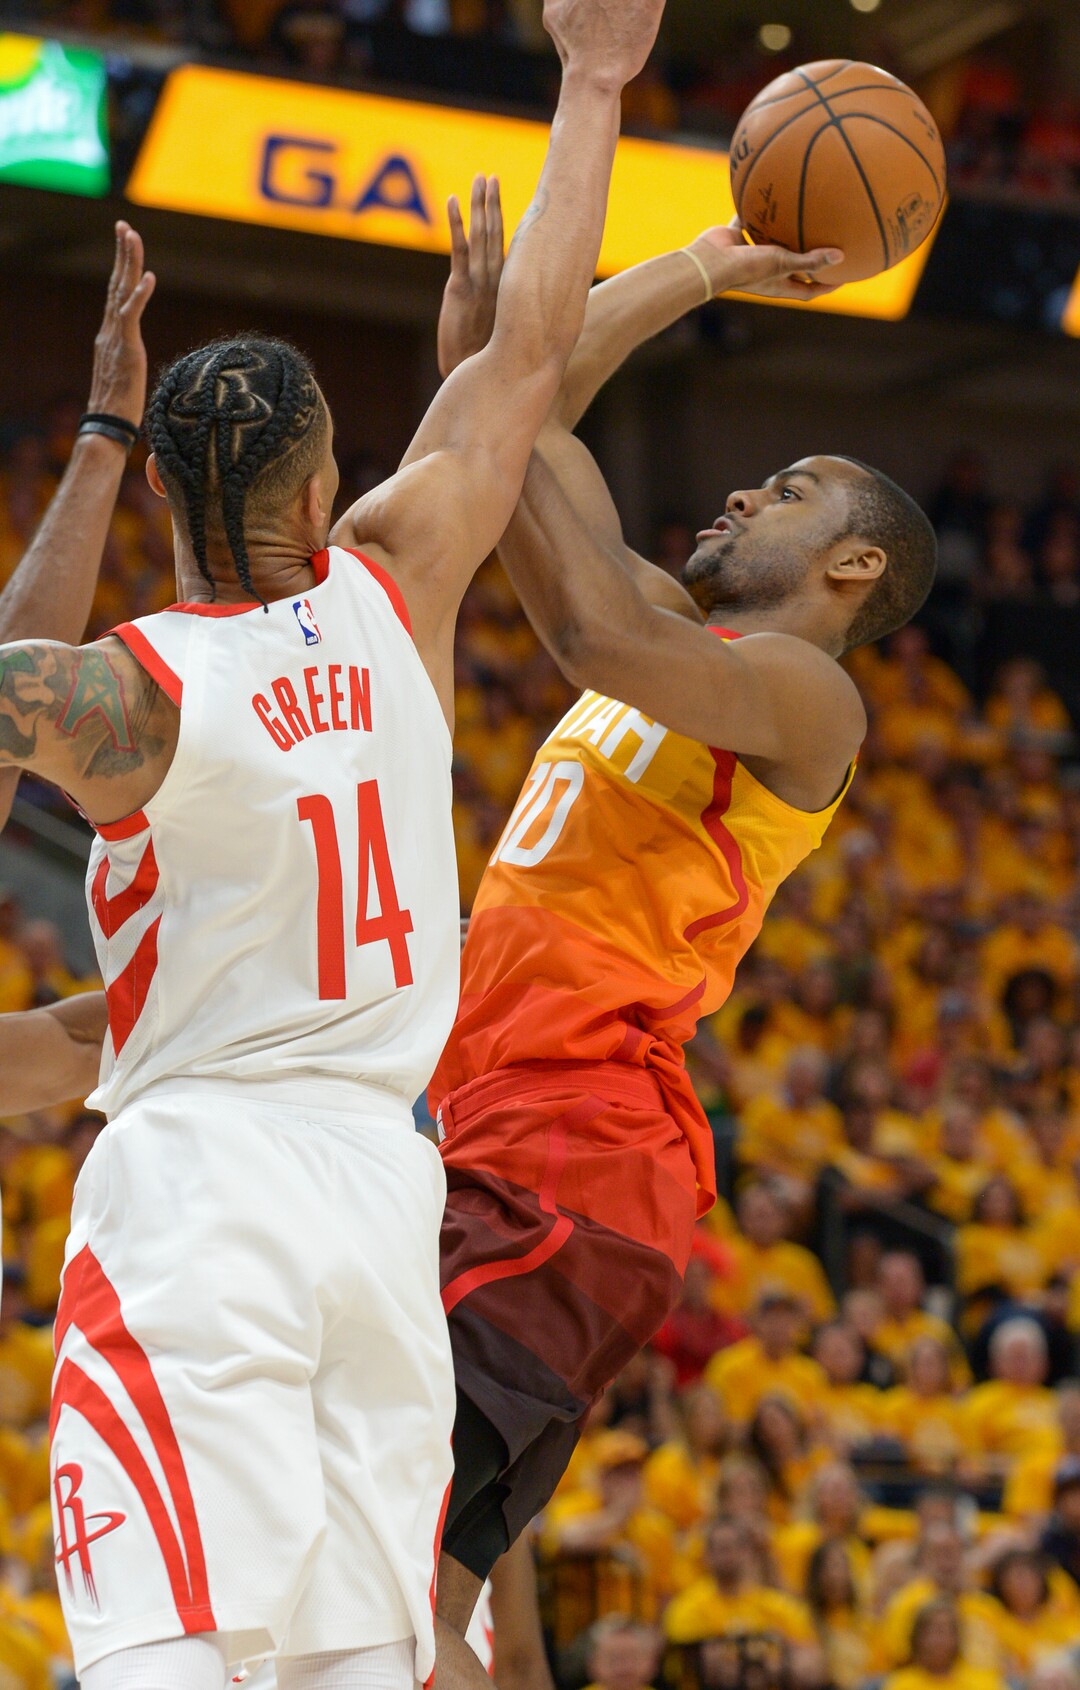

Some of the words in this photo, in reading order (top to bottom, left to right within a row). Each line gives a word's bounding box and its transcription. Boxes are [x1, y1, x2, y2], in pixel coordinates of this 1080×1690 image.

[252, 664, 372, 752] GREEN
[489, 760, 584, 868] 10
[296, 778, 414, 1000] 14
